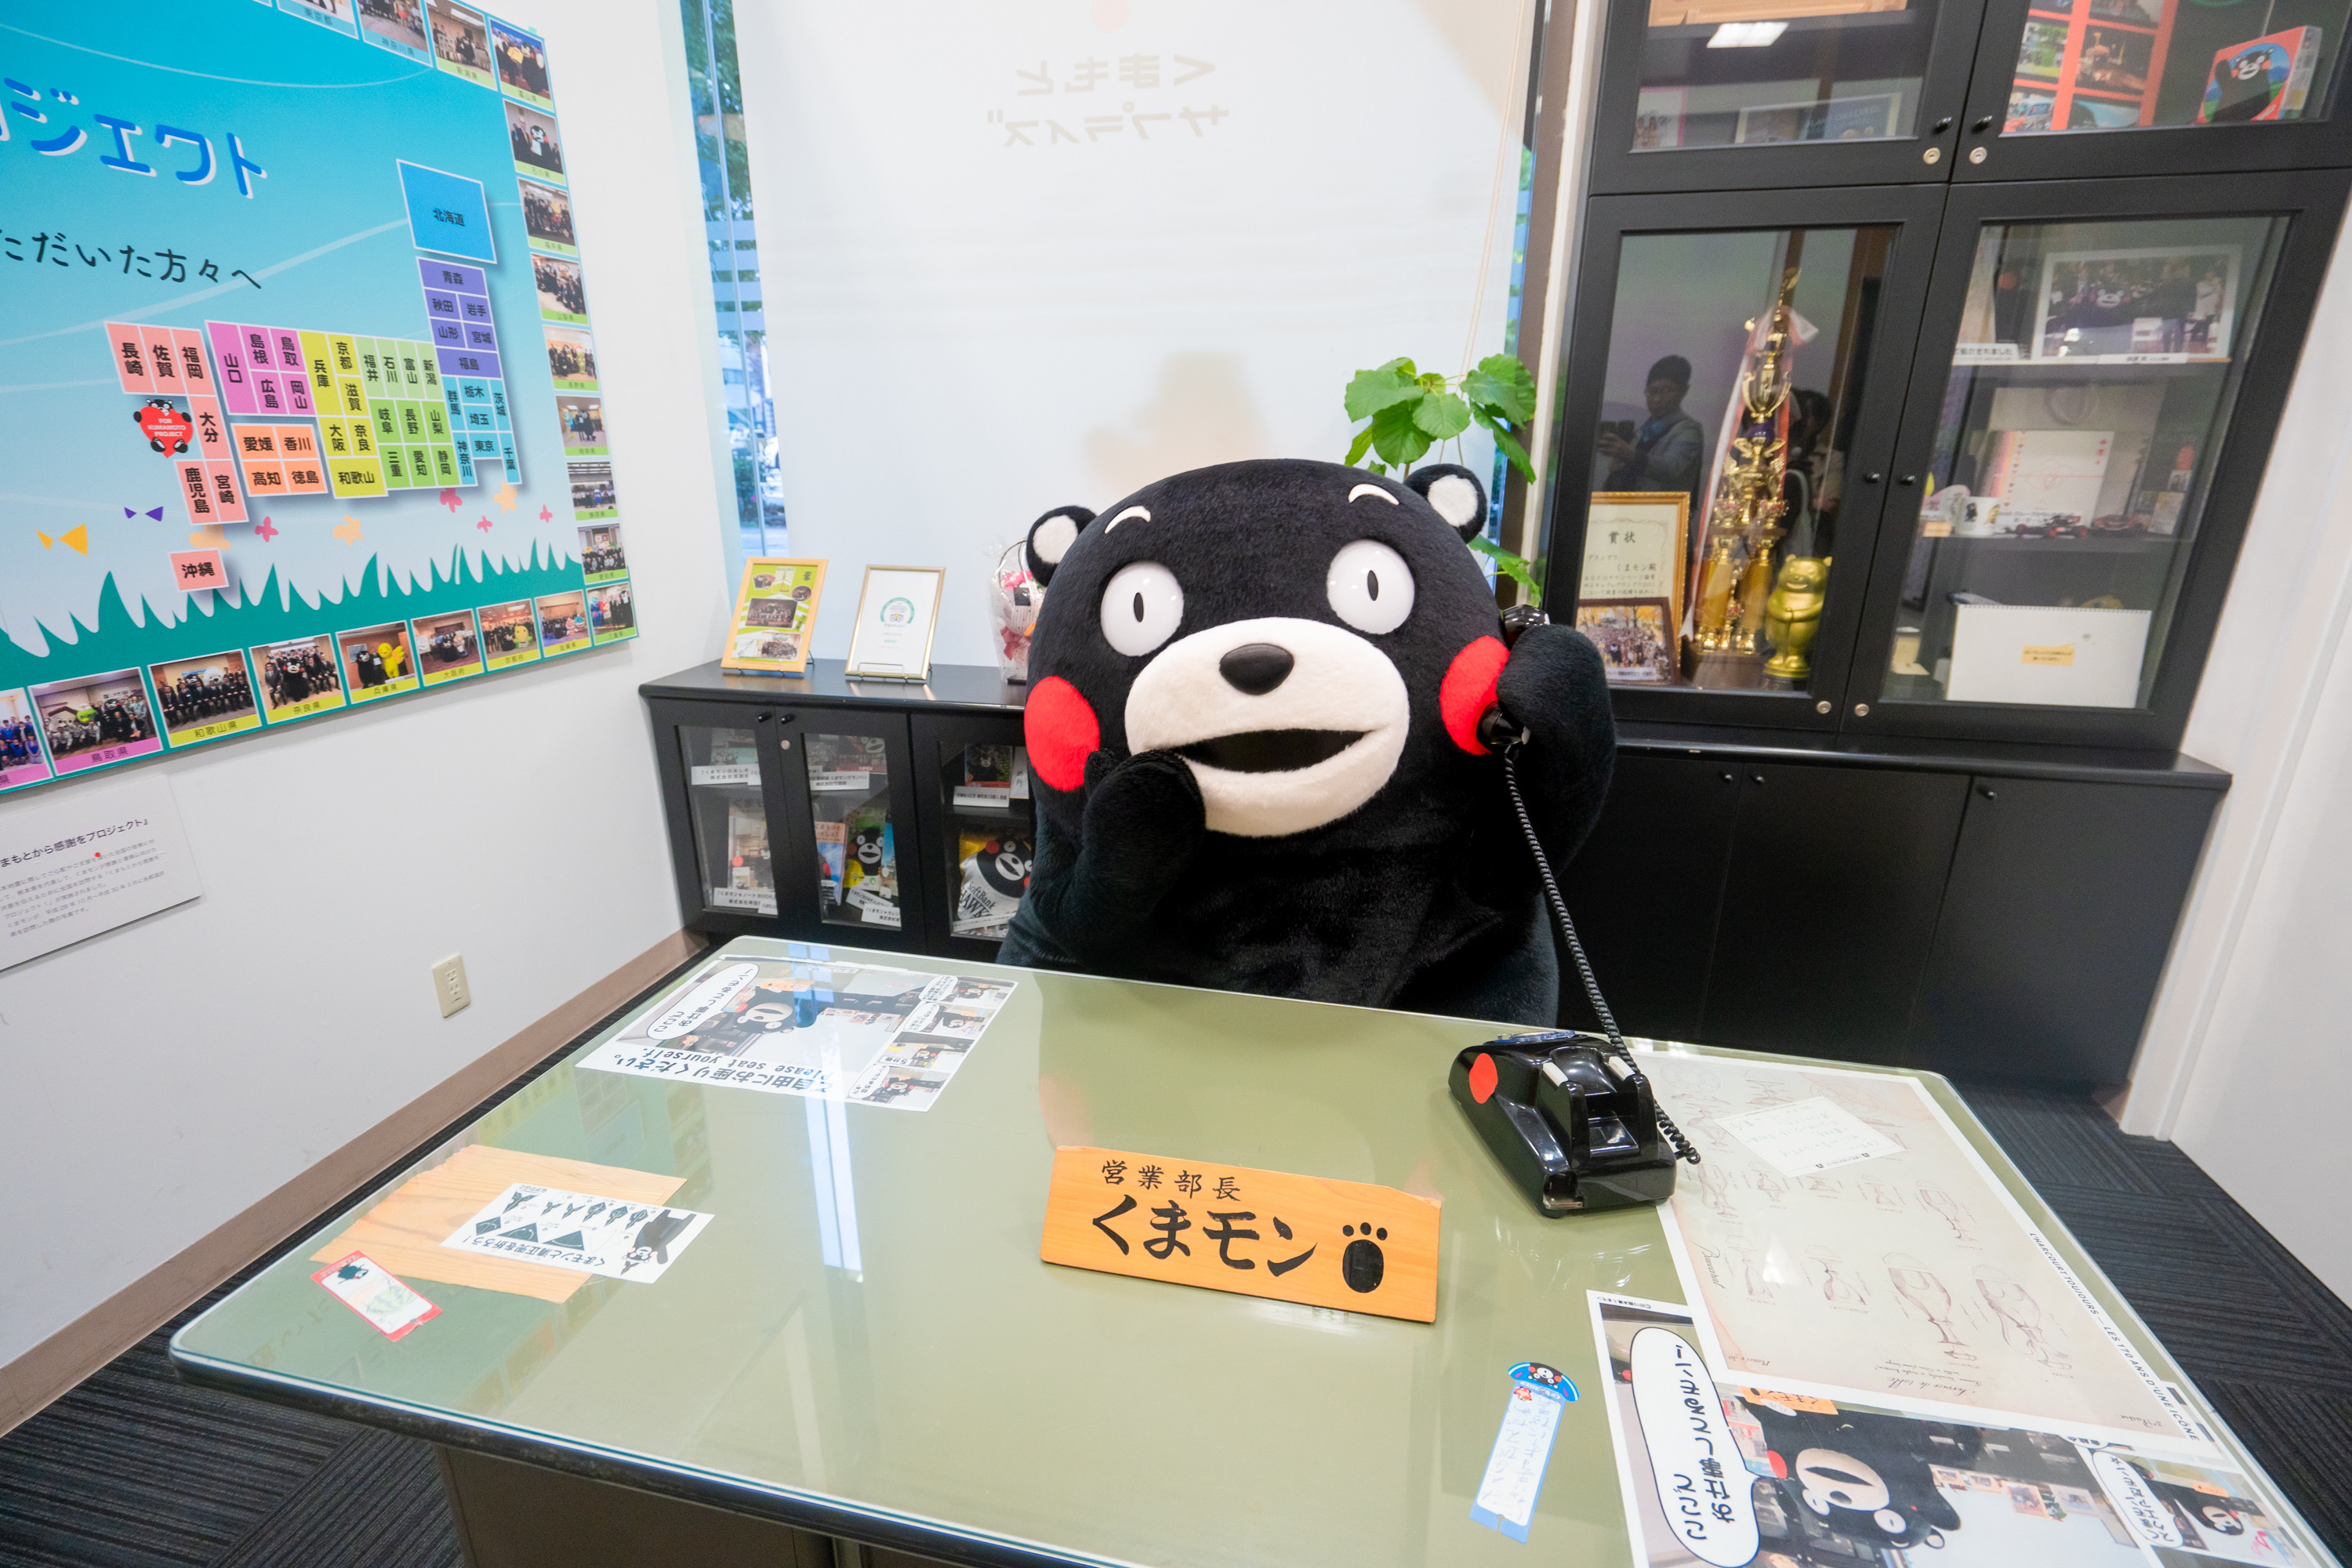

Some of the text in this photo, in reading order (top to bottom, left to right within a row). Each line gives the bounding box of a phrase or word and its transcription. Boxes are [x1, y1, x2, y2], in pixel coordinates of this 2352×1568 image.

[0, 77, 267, 199] ジェクト
[434, 208, 465, 227] 北海道
[442, 270, 464, 285] 青森
[433, 298, 453, 312] 秋田
[466, 303, 486, 317] 岩手
[437, 326, 459, 339] 山形
[471, 331, 492, 344] 宮城
[122, 343, 143, 376] 長崎
[153, 345, 175, 378] 佐賀
[250, 334, 269, 364] 島根
[281, 336, 299, 366] 鳥取
[336, 342, 352, 369] 京都
[182, 347, 203, 379] 福岡
[224, 354, 242, 383] 山口
[314, 360, 330, 387] 兵庫
[364, 355, 379, 382] 福井
[383, 357, 397, 383] 石川
[404, 358, 418, 384] 富山
[423, 360, 437, 385] 新潟
[459, 358, 480, 370] 福島
[261, 379, 278, 408] 広島
[291, 380, 308, 408] 岡山
[345, 383, 362, 411] 滋賀
[448, 390, 461, 416] 群馬
[464, 386, 485, 397] 栃木
[493, 393, 506, 416] 茨城
[200, 412, 218, 442] 大分
[378, 408, 394, 434] 岐阜
[405, 409, 419, 434] 長野
[431, 410, 444, 434] 山梨
[470, 413, 489, 425] 埼玉
[243, 437, 274, 452] 愛媛
[284, 437, 311, 451] 香川
[329, 424, 346, 451] 大阪
[354, 425, 371, 451] 奈良
[474, 440, 495, 452] 東京
[388, 452, 402, 477] 三重
[413, 450, 427, 476] 愛知
[437, 450, 451, 475] 静岡
[456, 441, 472, 477] 神奈川
[504, 447, 516, 470] 千葉
[215, 475, 234, 504] 宮崎
[252, 472, 281, 486] 高知
[292, 470, 319, 484] 徳島
[338, 471, 375, 485] 和歌山
[185, 468, 209, 514] 鹿児島
[1610, 531, 1636, 544] 賞状
[182, 562, 215, 579] 沖縄
[292, 700, 321, 716] 奈良県
[194, 719, 238, 739] 和歌山県
[91, 746, 129, 764] 鳥取県
[960, 890, 994, 917] HAWK
[968, 880, 996, 909] SoftBank
[655, 1011, 684, 1033] ここで
[615, 1054, 833, 1093] ご自由にお座りください。
[643, 1047, 833, 1081] Please seat yourself.
[1102, 1160, 1241, 1201] 営業部長
[1092, 1194, 1317, 1278] くまモン
[2030, 1232, 2067, 1276] L'HARCOURT
[2064, 1277, 2099, 1315] TOUJOURS
[2103, 1327, 2120, 1342] LES
[2118, 1344, 2133, 1358] 170
[2130, 1360, 2149, 1377] ANS
[2147, 1379, 2174, 1408] D'UNE
[1674, 1474, 1707, 1540] ここで
[2125, 1497, 2159, 1539] くまモン
